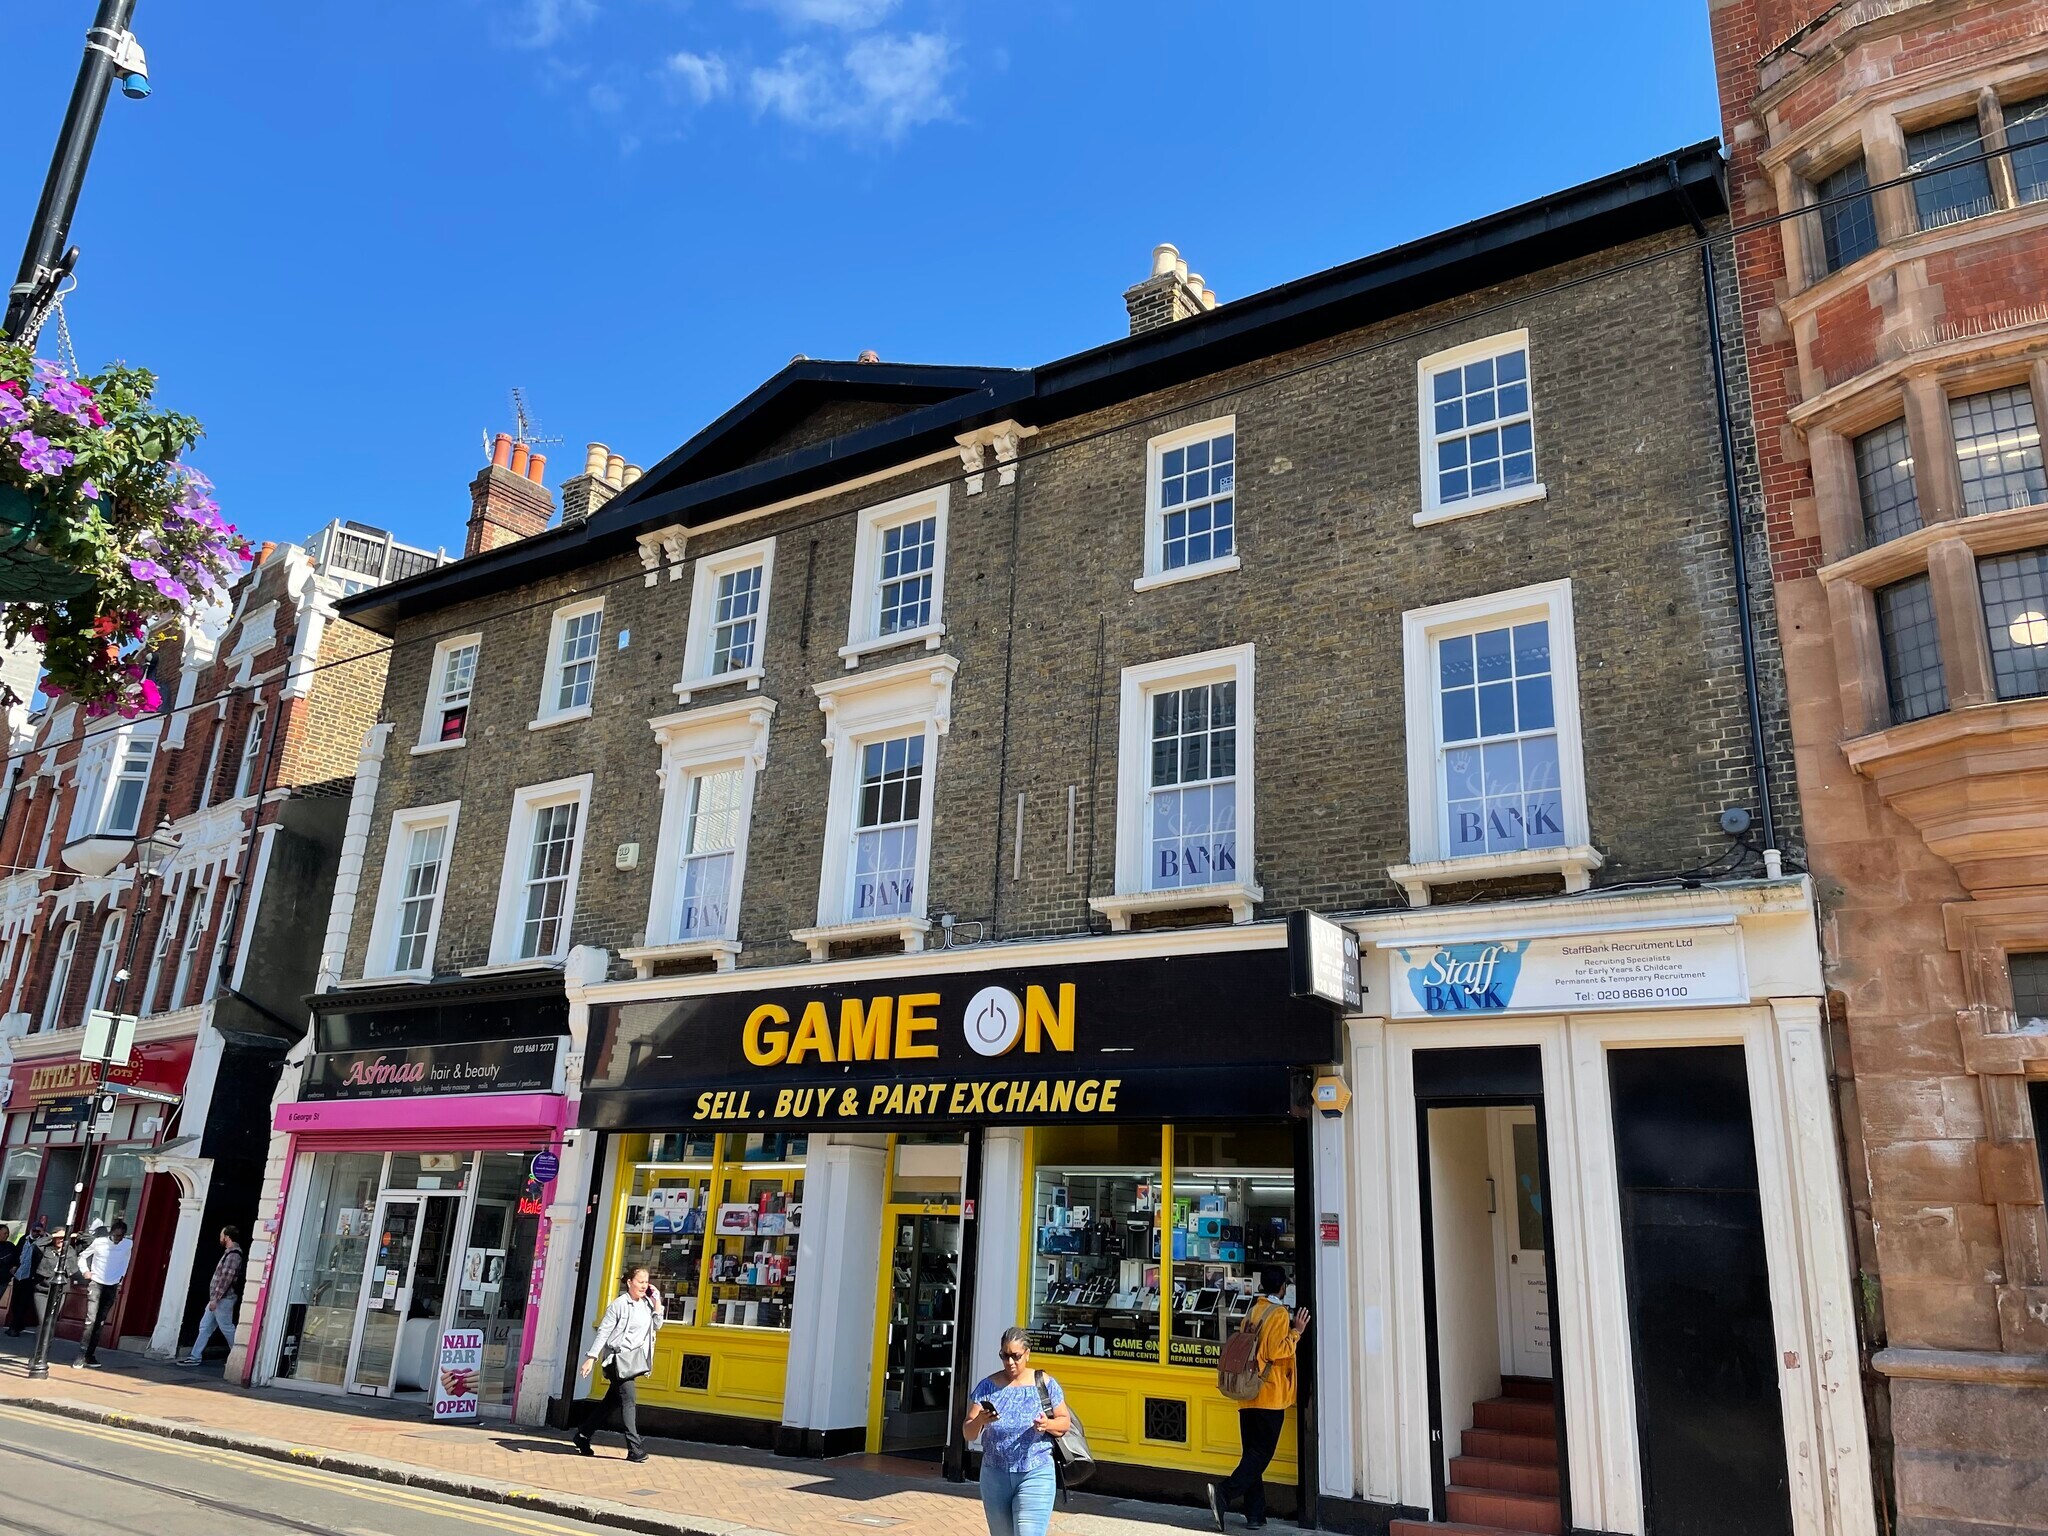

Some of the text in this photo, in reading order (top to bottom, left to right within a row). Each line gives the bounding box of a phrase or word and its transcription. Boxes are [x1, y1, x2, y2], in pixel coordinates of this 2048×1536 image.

[1458, 802, 1564, 843] BANK
[1159, 842, 1235, 878] BANK
[1562, 938, 1692, 955] StaffBank Recruitment Ltd
[1584, 955, 1671, 966] Recruiting Specialists
[1423, 946, 1508, 994] Staff
[1589, 968, 1608, 976] Early
[1608, 975, 1651, 983] Temporary
[1654, 972, 1706, 980] Recruitment
[1423, 983, 1507, 1010] BANK
[1575, 987, 1688, 1001] Tel: 020 8686 0100
[742, 982, 1076, 1066] GAME ON
[514, 1043, 554, 1054] 020 8681 2273
[29, 1064, 77, 1090] LITTLE
[430, 1065, 451, 1080] hair
[453, 1064, 461, 1078] &
[465, 1062, 500, 1080] beauty
[158, 1094, 172, 1102] Library
[693, 1091, 750, 1120] SELL
[774, 1088, 835, 1117] BUY
[838, 1088, 859, 1116] &
[868, 1084, 948, 1115] PART
[950, 1080, 1121, 1115] EXCHANGE
[293, 1113, 312, 1122] George
[518, 1197, 542, 1214] Nails
[443, 1335, 481, 1349] NAIL
[1113, 1338, 1142, 1349] GAME
[1113, 1350, 1135, 1358] REPAIR
[1170, 1343, 1220, 1356] GAME ON
[441, 1350, 475, 1364] BAR
[436, 1400, 476, 1414] OPEN
